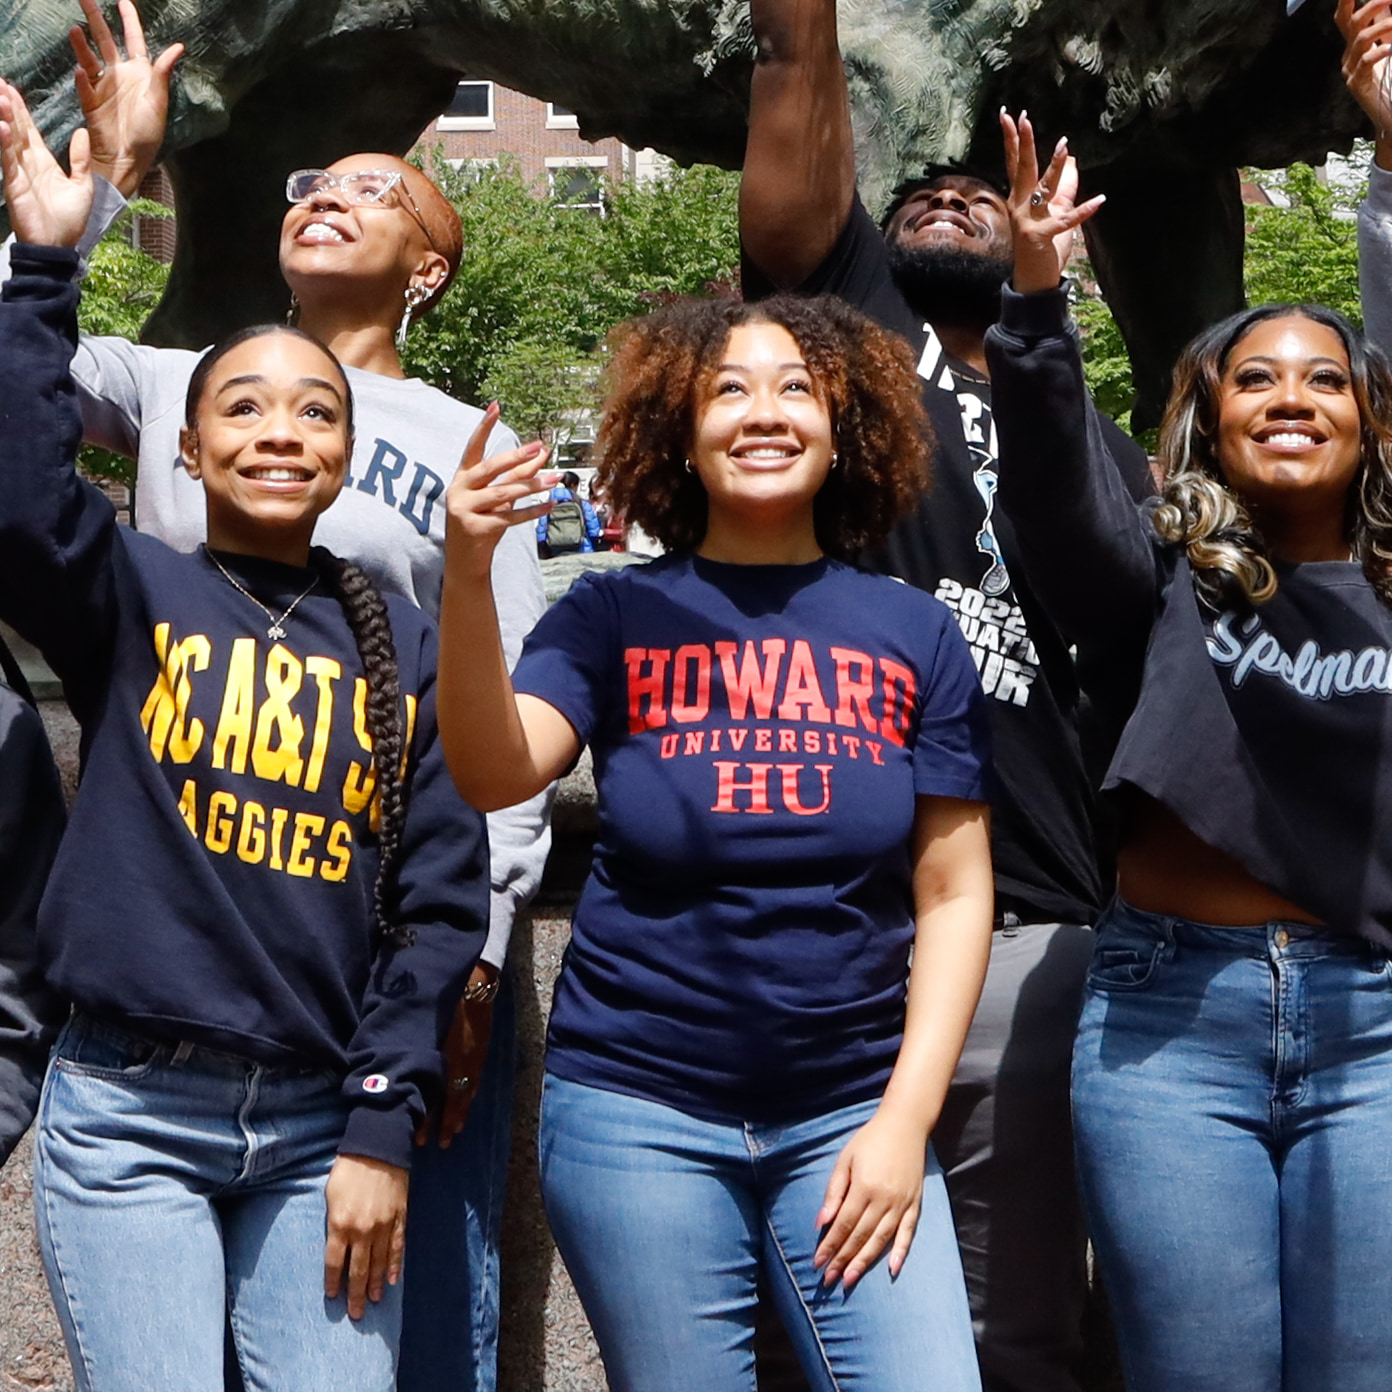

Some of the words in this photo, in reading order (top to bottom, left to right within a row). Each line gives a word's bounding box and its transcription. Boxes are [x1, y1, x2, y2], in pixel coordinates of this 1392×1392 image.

[345, 437, 445, 536] RD
[212, 638, 341, 794] A&T
[624, 638, 918, 748] HOWARD
[660, 728, 885, 765] UNIVERSITY
[710, 760, 834, 816] HU
[177, 778, 353, 883] AGGIES
